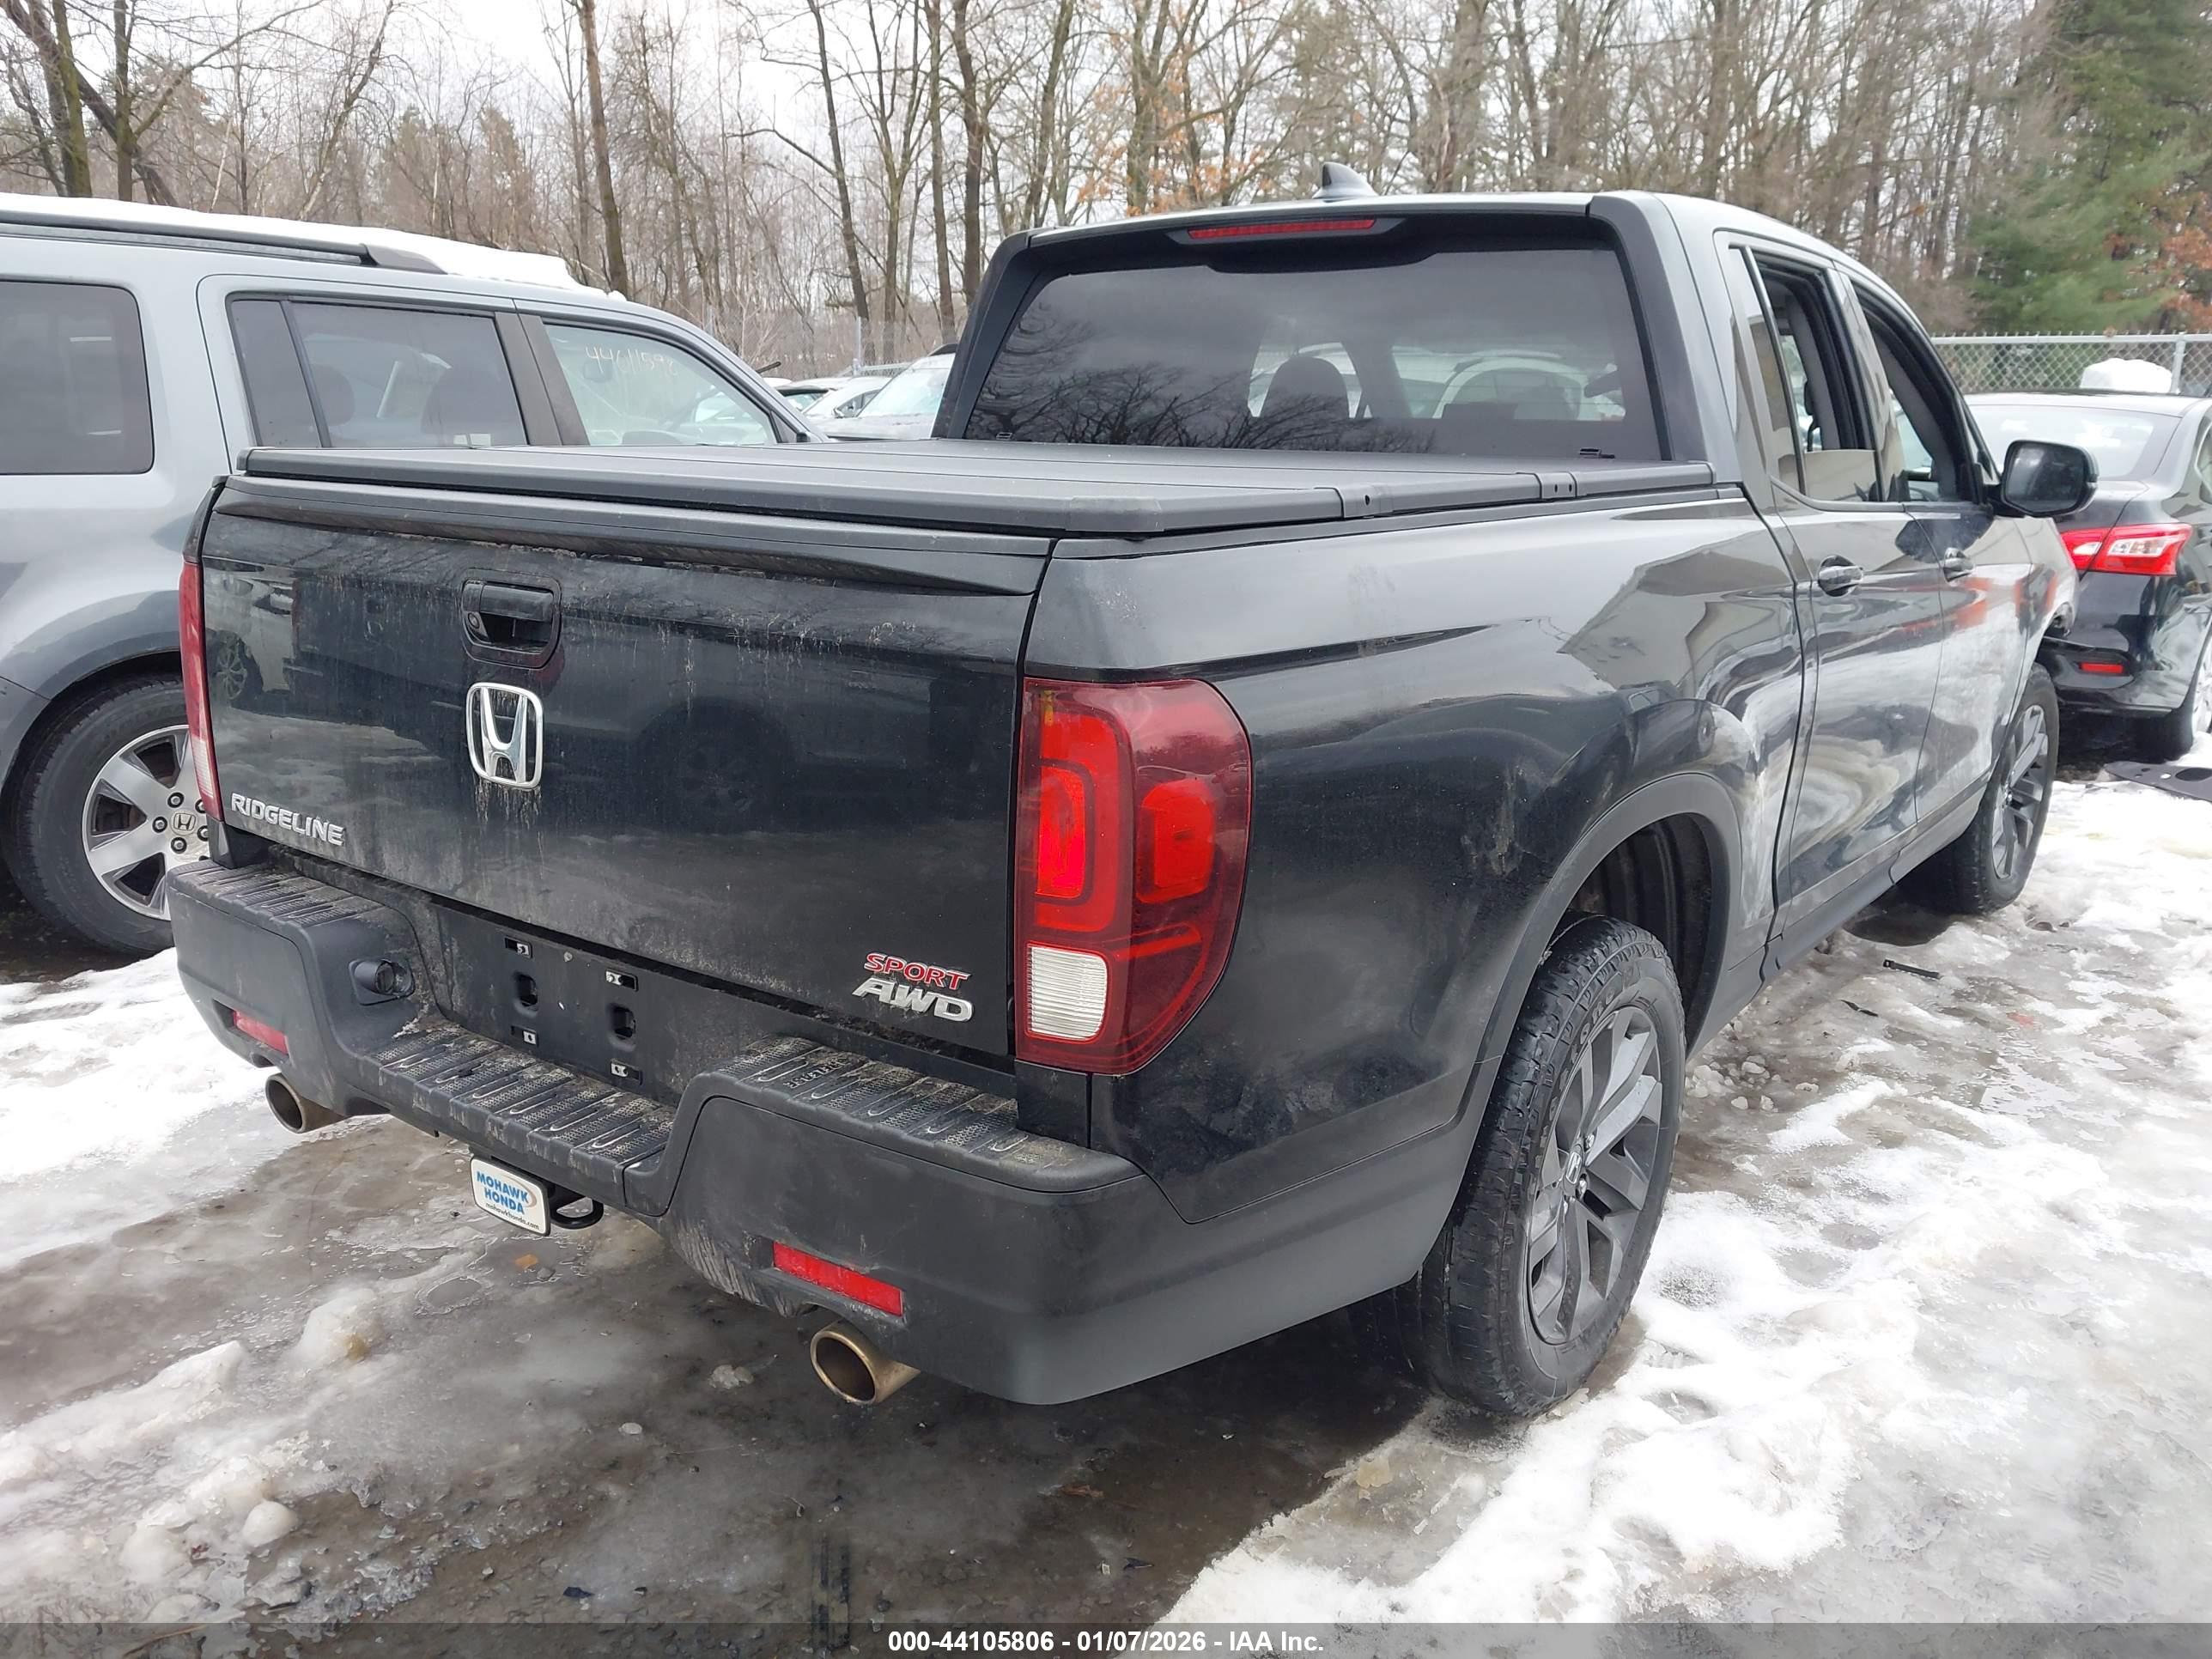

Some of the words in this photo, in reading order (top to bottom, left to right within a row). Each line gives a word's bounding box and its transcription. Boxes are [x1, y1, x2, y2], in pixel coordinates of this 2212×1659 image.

[231, 792, 346, 846] RIDGELINE
[864, 952, 971, 989] SPORT
[852, 977, 975, 1022] AWD
[477, 1171, 529, 1203] MOHAWK
[484, 1188, 525, 1215] HONDA
[485, 1202, 540, 1231] mohawkhonda.com
